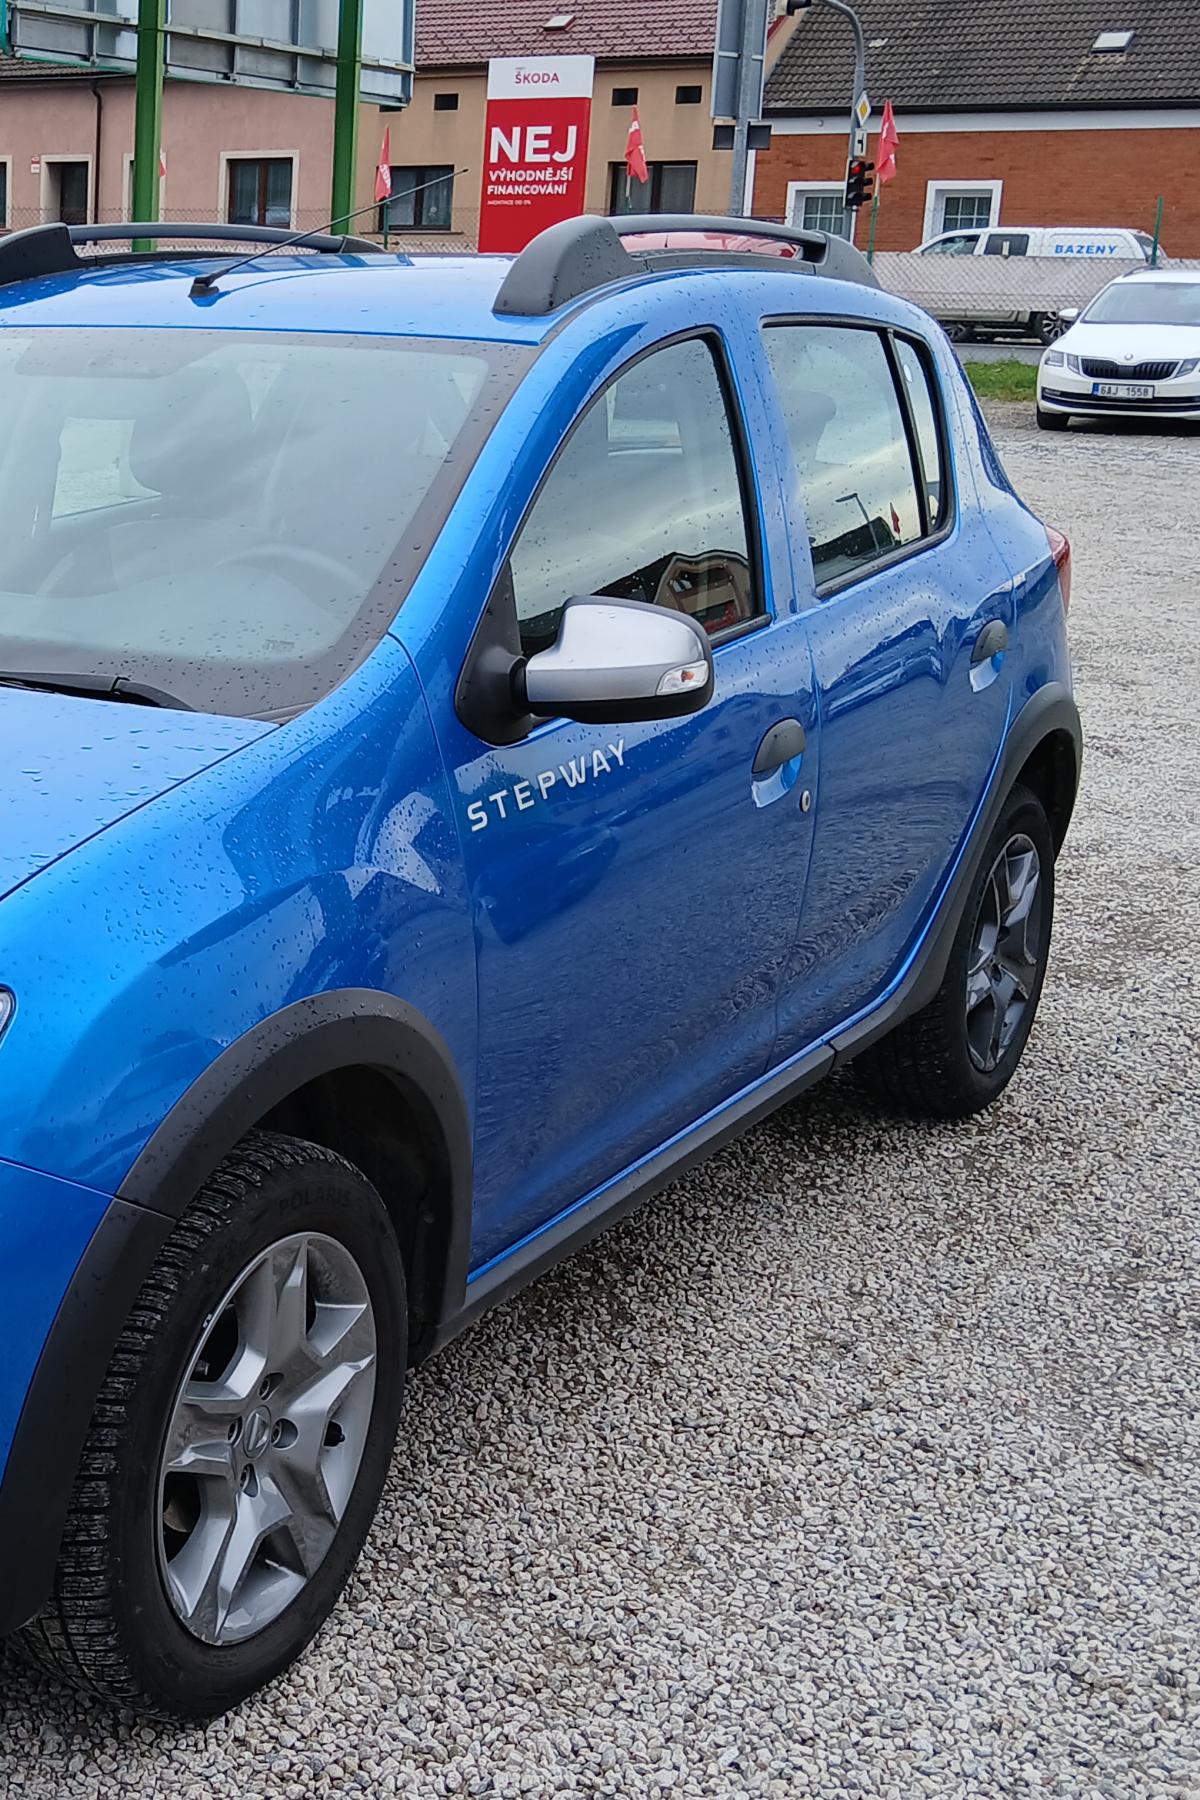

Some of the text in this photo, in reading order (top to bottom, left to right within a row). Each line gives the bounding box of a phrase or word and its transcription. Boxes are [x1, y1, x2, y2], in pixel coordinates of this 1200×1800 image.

[515, 71, 560, 84] ŠKODA
[489, 125, 578, 164] NEJ
[488, 166, 574, 182] VÝHODNĚJŠÍ
[487, 182, 568, 195] FINANCOVÁNÍ
[1100, 385, 1119, 396] 6AJ
[467, 739, 625, 832] STEPWAY
